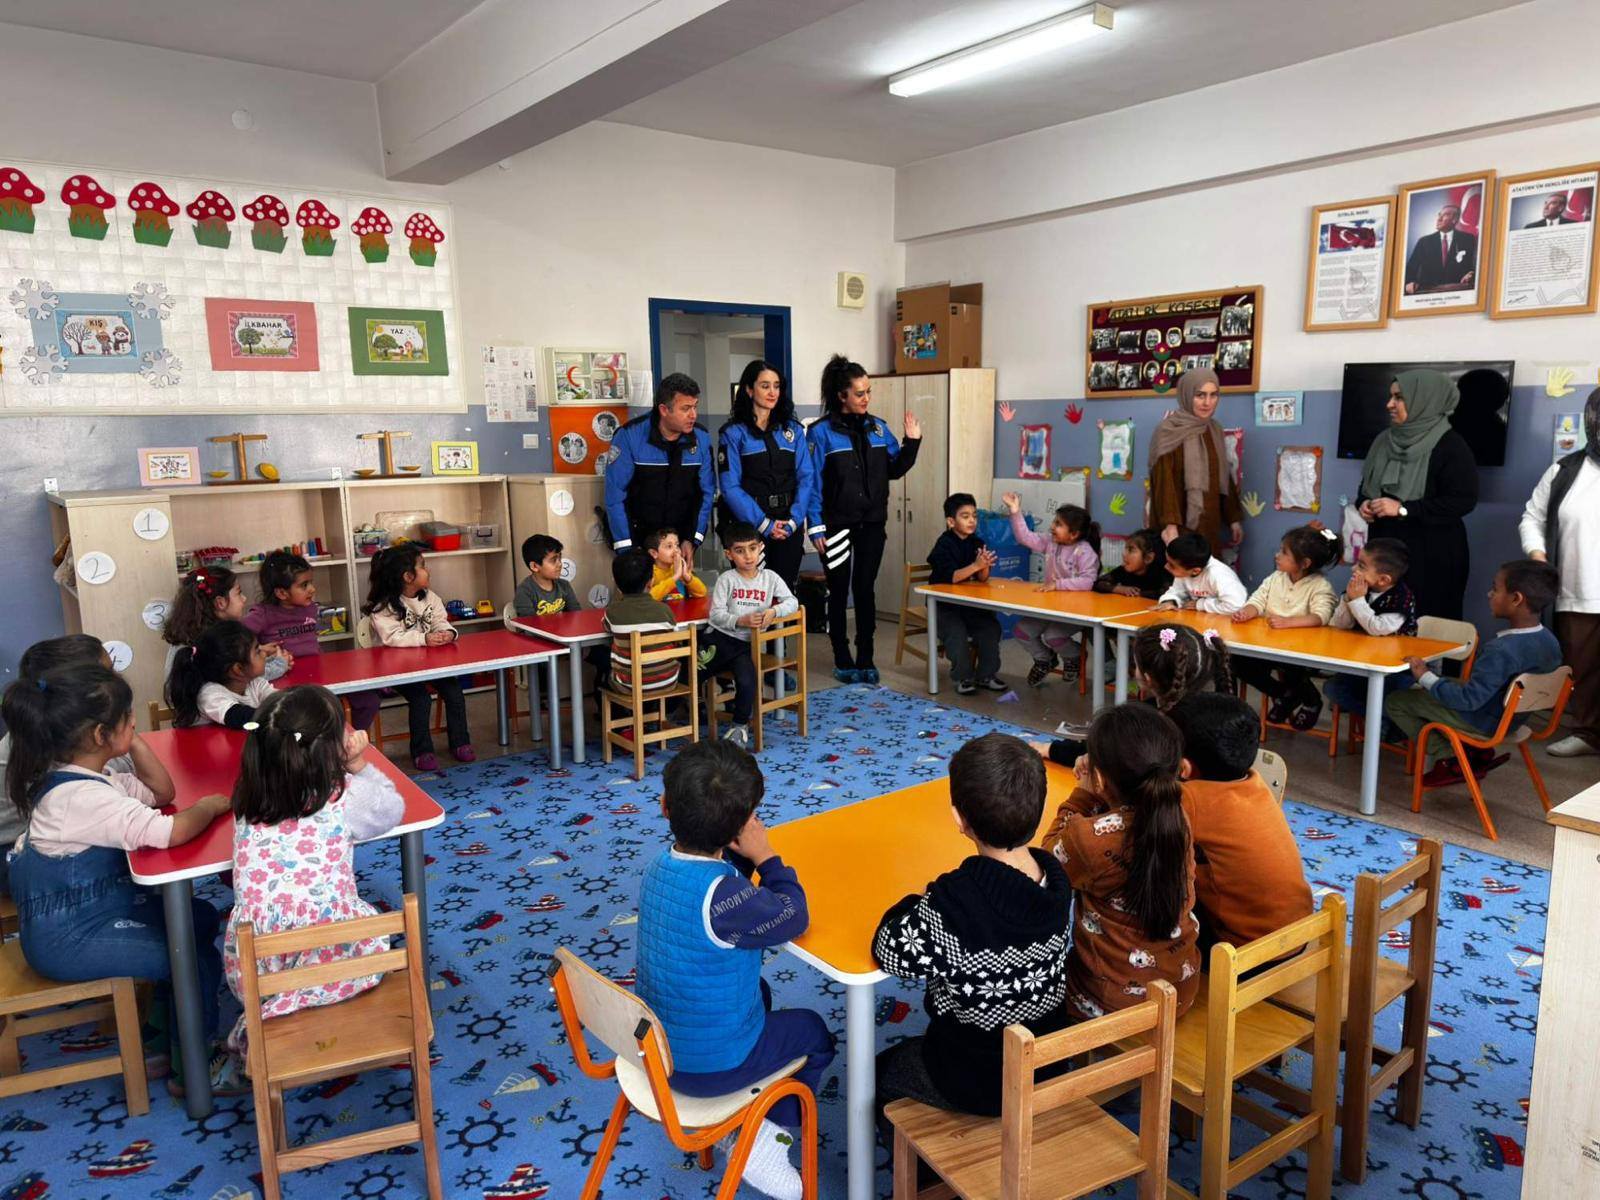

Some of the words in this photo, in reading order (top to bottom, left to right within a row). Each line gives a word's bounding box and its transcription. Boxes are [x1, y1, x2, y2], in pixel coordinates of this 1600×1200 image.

[140, 513, 160, 532] 1
[85, 557, 110, 580] 2
[731, 588, 766, 602] SUPER
[150, 604, 165, 626] 3
